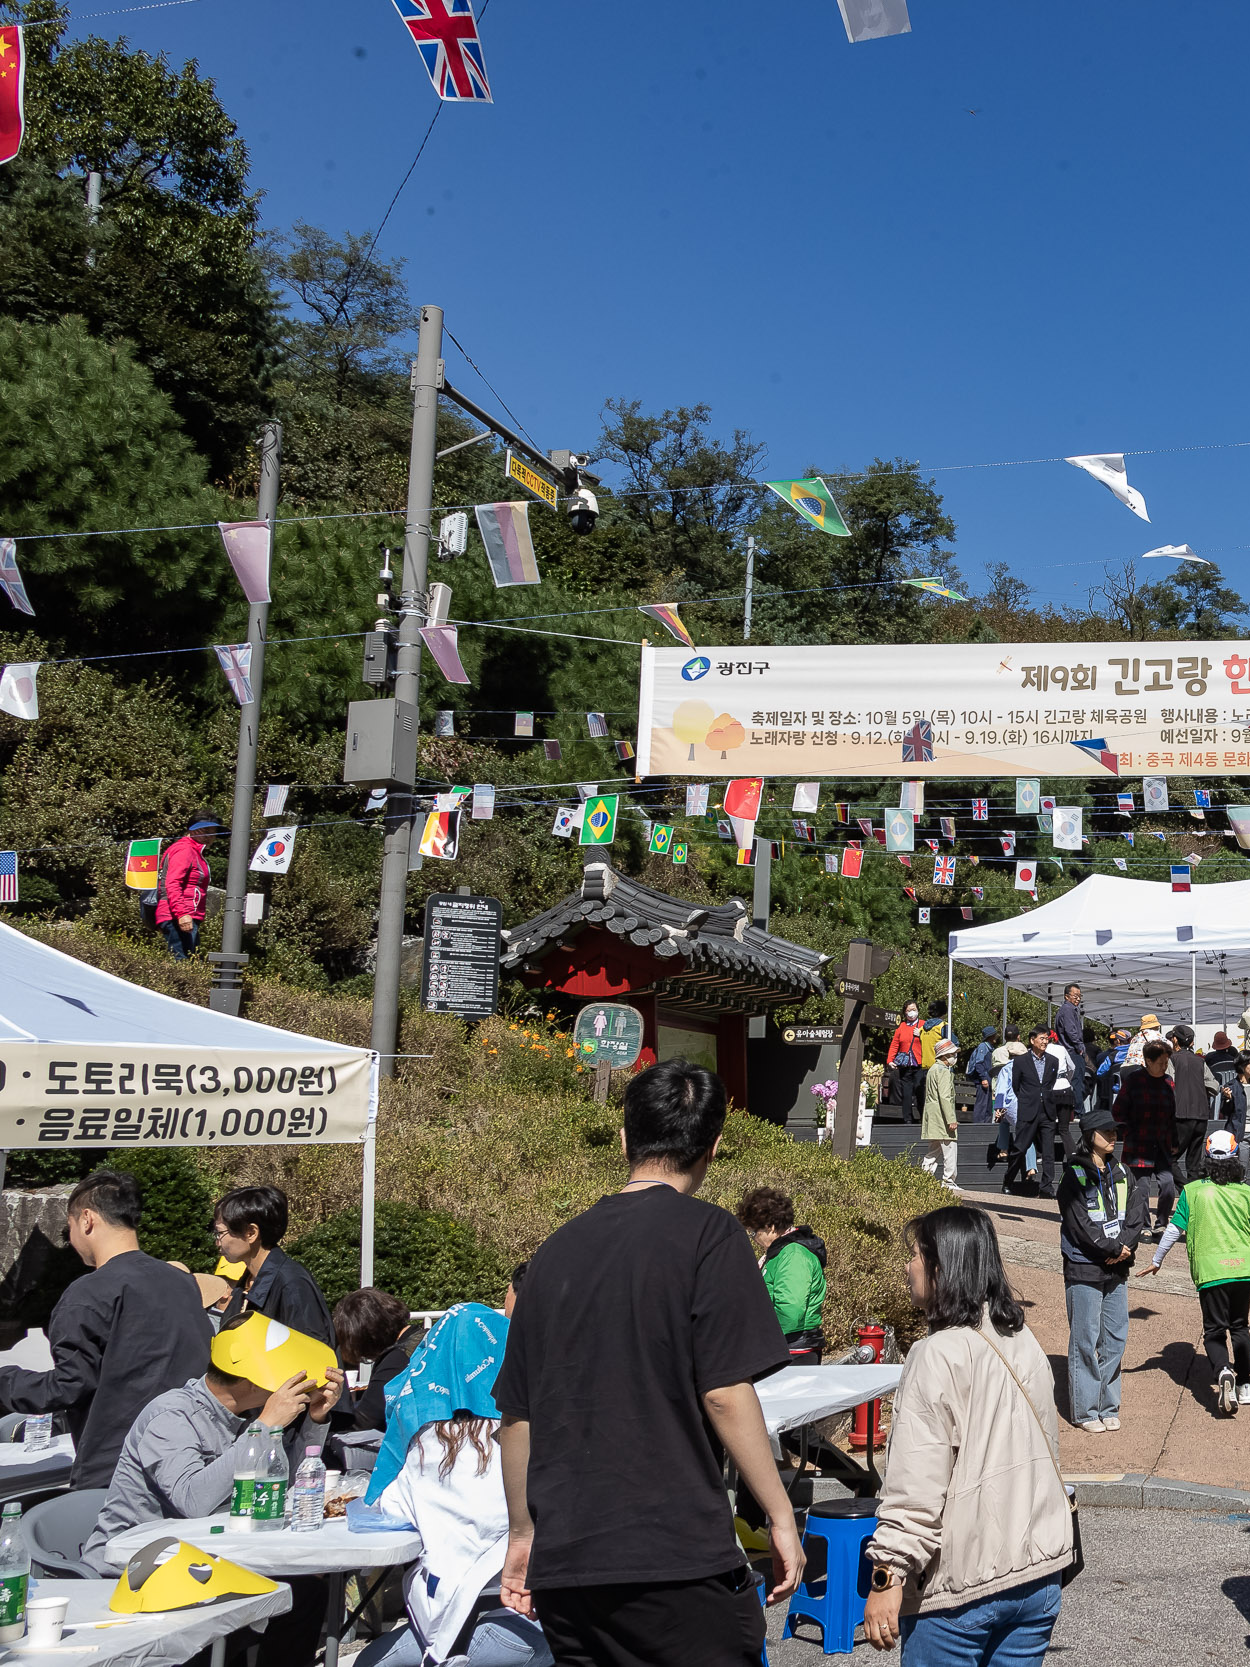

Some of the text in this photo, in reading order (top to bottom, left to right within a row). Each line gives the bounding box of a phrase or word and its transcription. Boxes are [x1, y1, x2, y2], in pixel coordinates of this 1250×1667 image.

[716, 661, 771, 675] 광진구
[1021, 663, 1097, 692] 제9회
[1108, 656, 1212, 696] 긴고랑
[751, 710, 807, 726] 축제일자
[811, 710, 824, 725] 및
[865, 710, 897, 726] 10월
[930, 709, 955, 725] (목)
[961, 709, 992, 725] 10시
[1007, 709, 1039, 725] 15시
[1044, 709, 1086, 725] 긴고랑
[1090, 708, 1147, 724] 체육공원
[1161, 708, 1218, 724] 행사내용
[750, 731, 807, 746] 노래자랑
[811, 731, 838, 746] 신청
[851, 730, 905, 746] 9.12.(화
[965, 729, 1028, 746] 9.19.(화)
[1161, 728, 1218, 744] 예선일자
[1146, 751, 1174, 768] 중곡
[1179, 751, 1218, 768] 제4동
[601, 1040, 628, 1050] 화장실
[45, 1060, 337, 1097] 도토리묵(3,000원)
[37, 1106, 328, 1142] 음료일체(1,000원)
